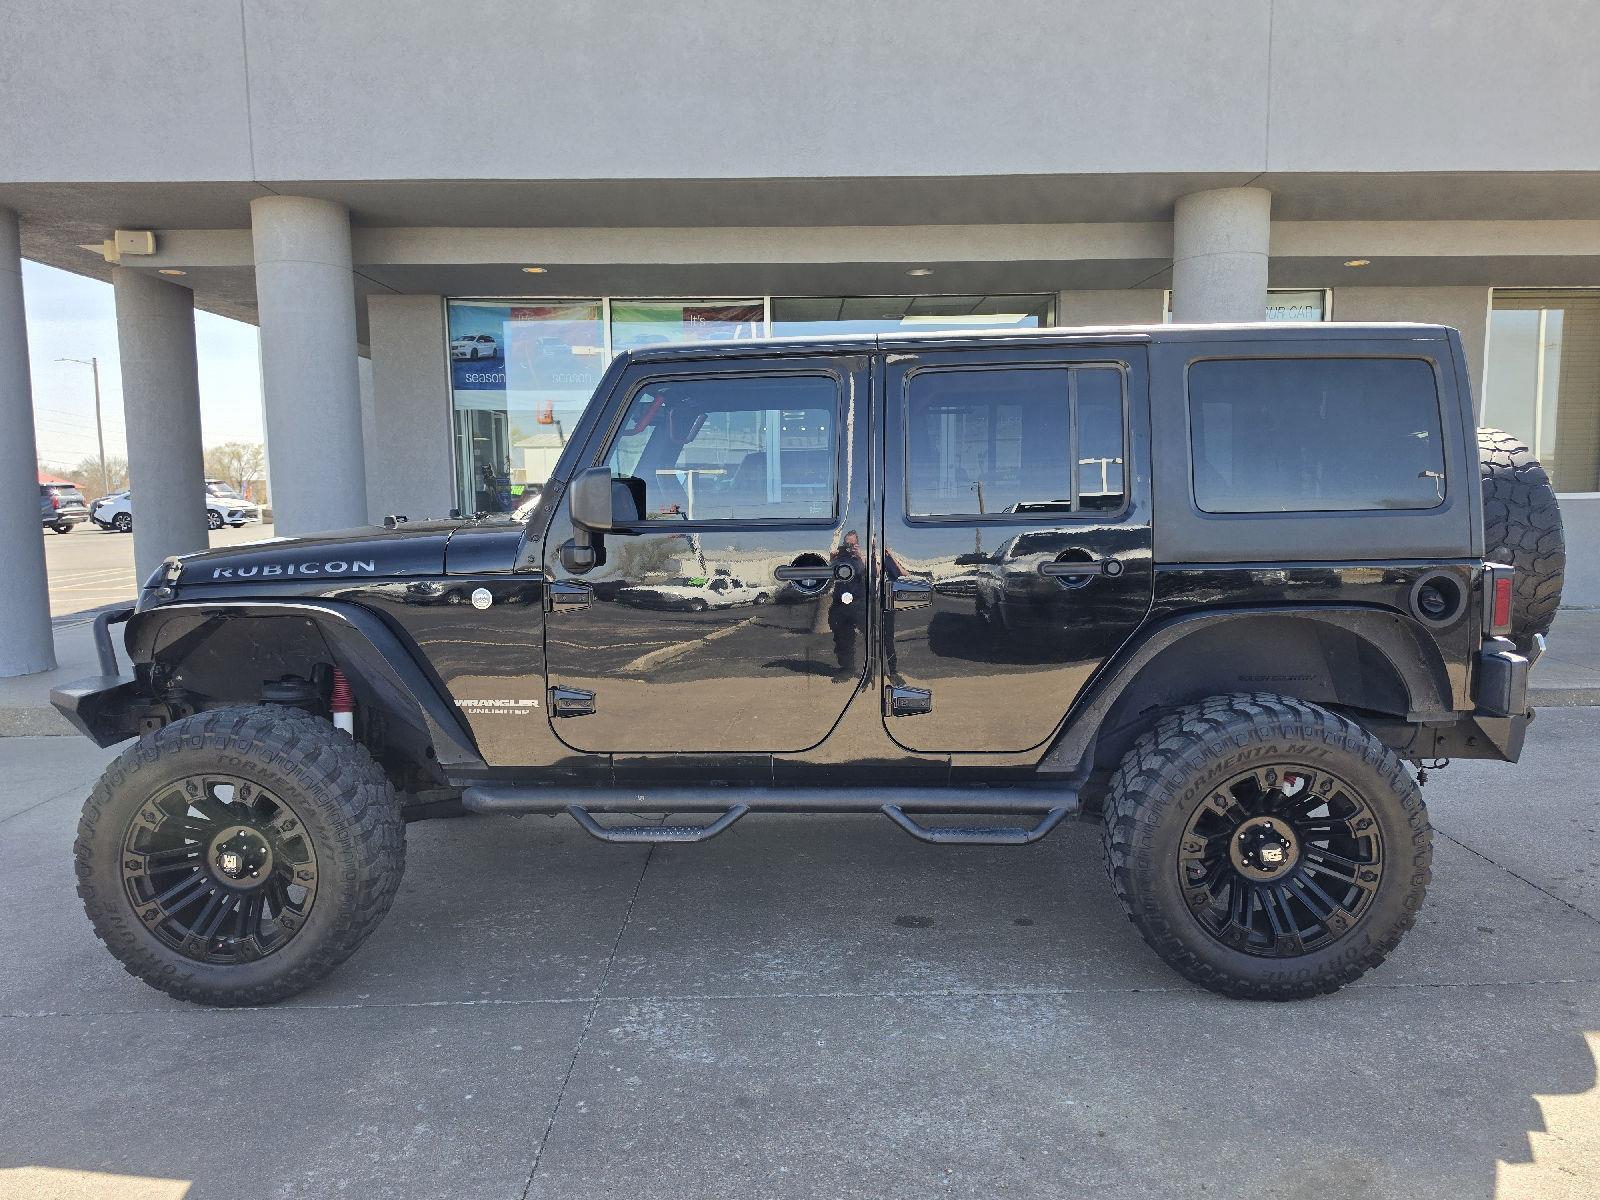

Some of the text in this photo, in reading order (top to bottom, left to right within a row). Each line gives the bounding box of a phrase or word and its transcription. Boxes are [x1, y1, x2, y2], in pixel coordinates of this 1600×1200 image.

[1265, 305, 1313, 319] UR CAR
[690, 314, 706, 327] It's
[465, 373, 506, 383] season
[213, 560, 375, 578] RUBICON
[454, 699, 540, 708] WRANGLER
[1175, 743, 1278, 811] TORMENTA
